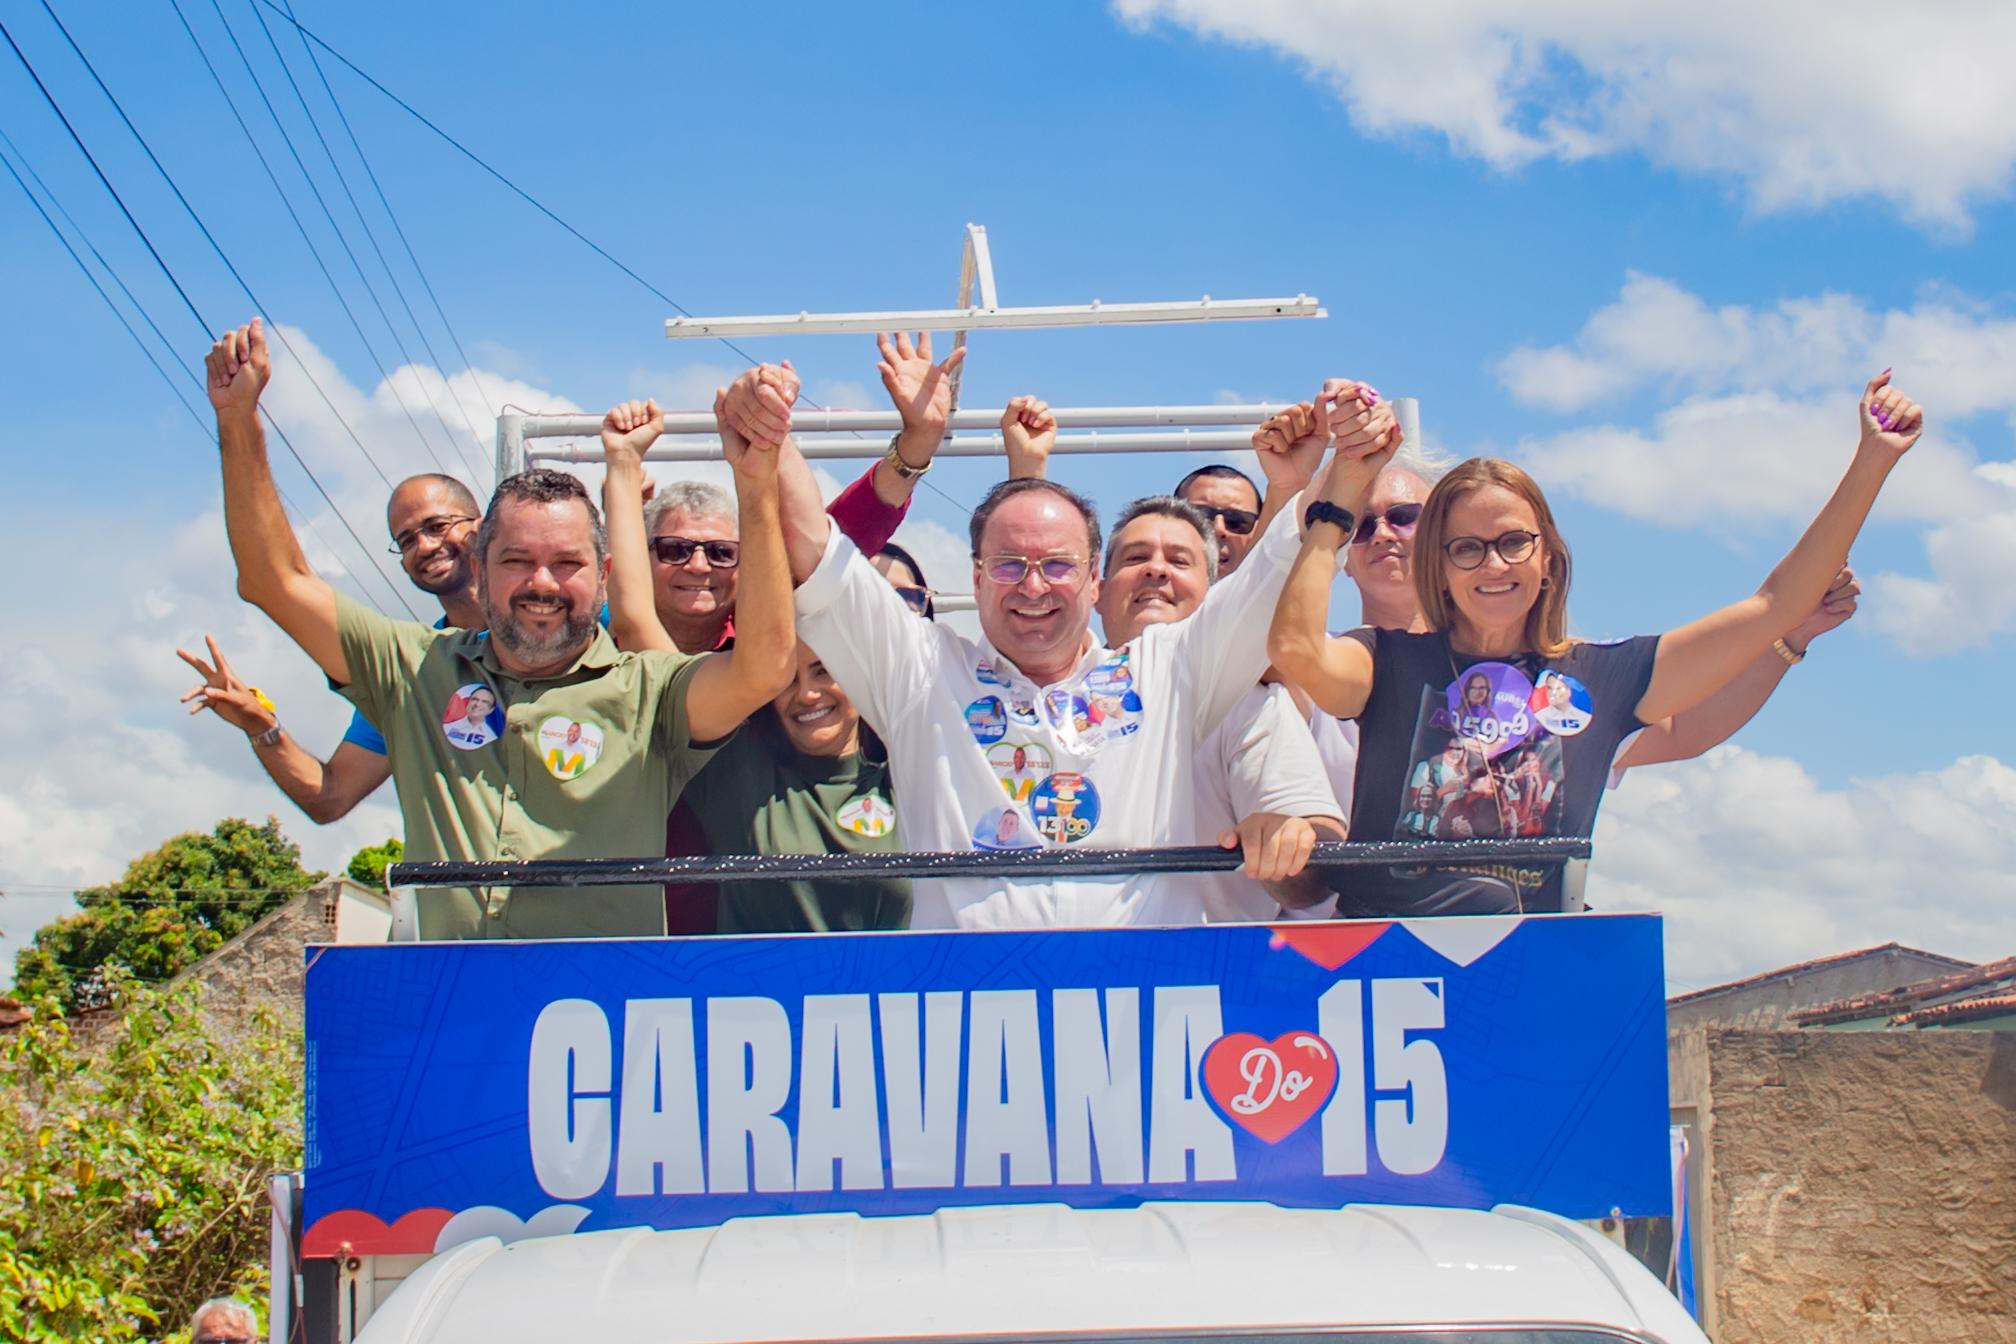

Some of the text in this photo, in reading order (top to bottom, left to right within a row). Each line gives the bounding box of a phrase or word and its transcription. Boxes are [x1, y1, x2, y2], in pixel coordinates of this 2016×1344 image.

[1120, 722, 1139, 736] 15
[1561, 719, 1580, 728] 15
[466, 733, 486, 745] 15
[528, 985, 1237, 1199] CARAVANA
[1231, 1047, 1313, 1115] Do
[1317, 976, 1448, 1177] 15
